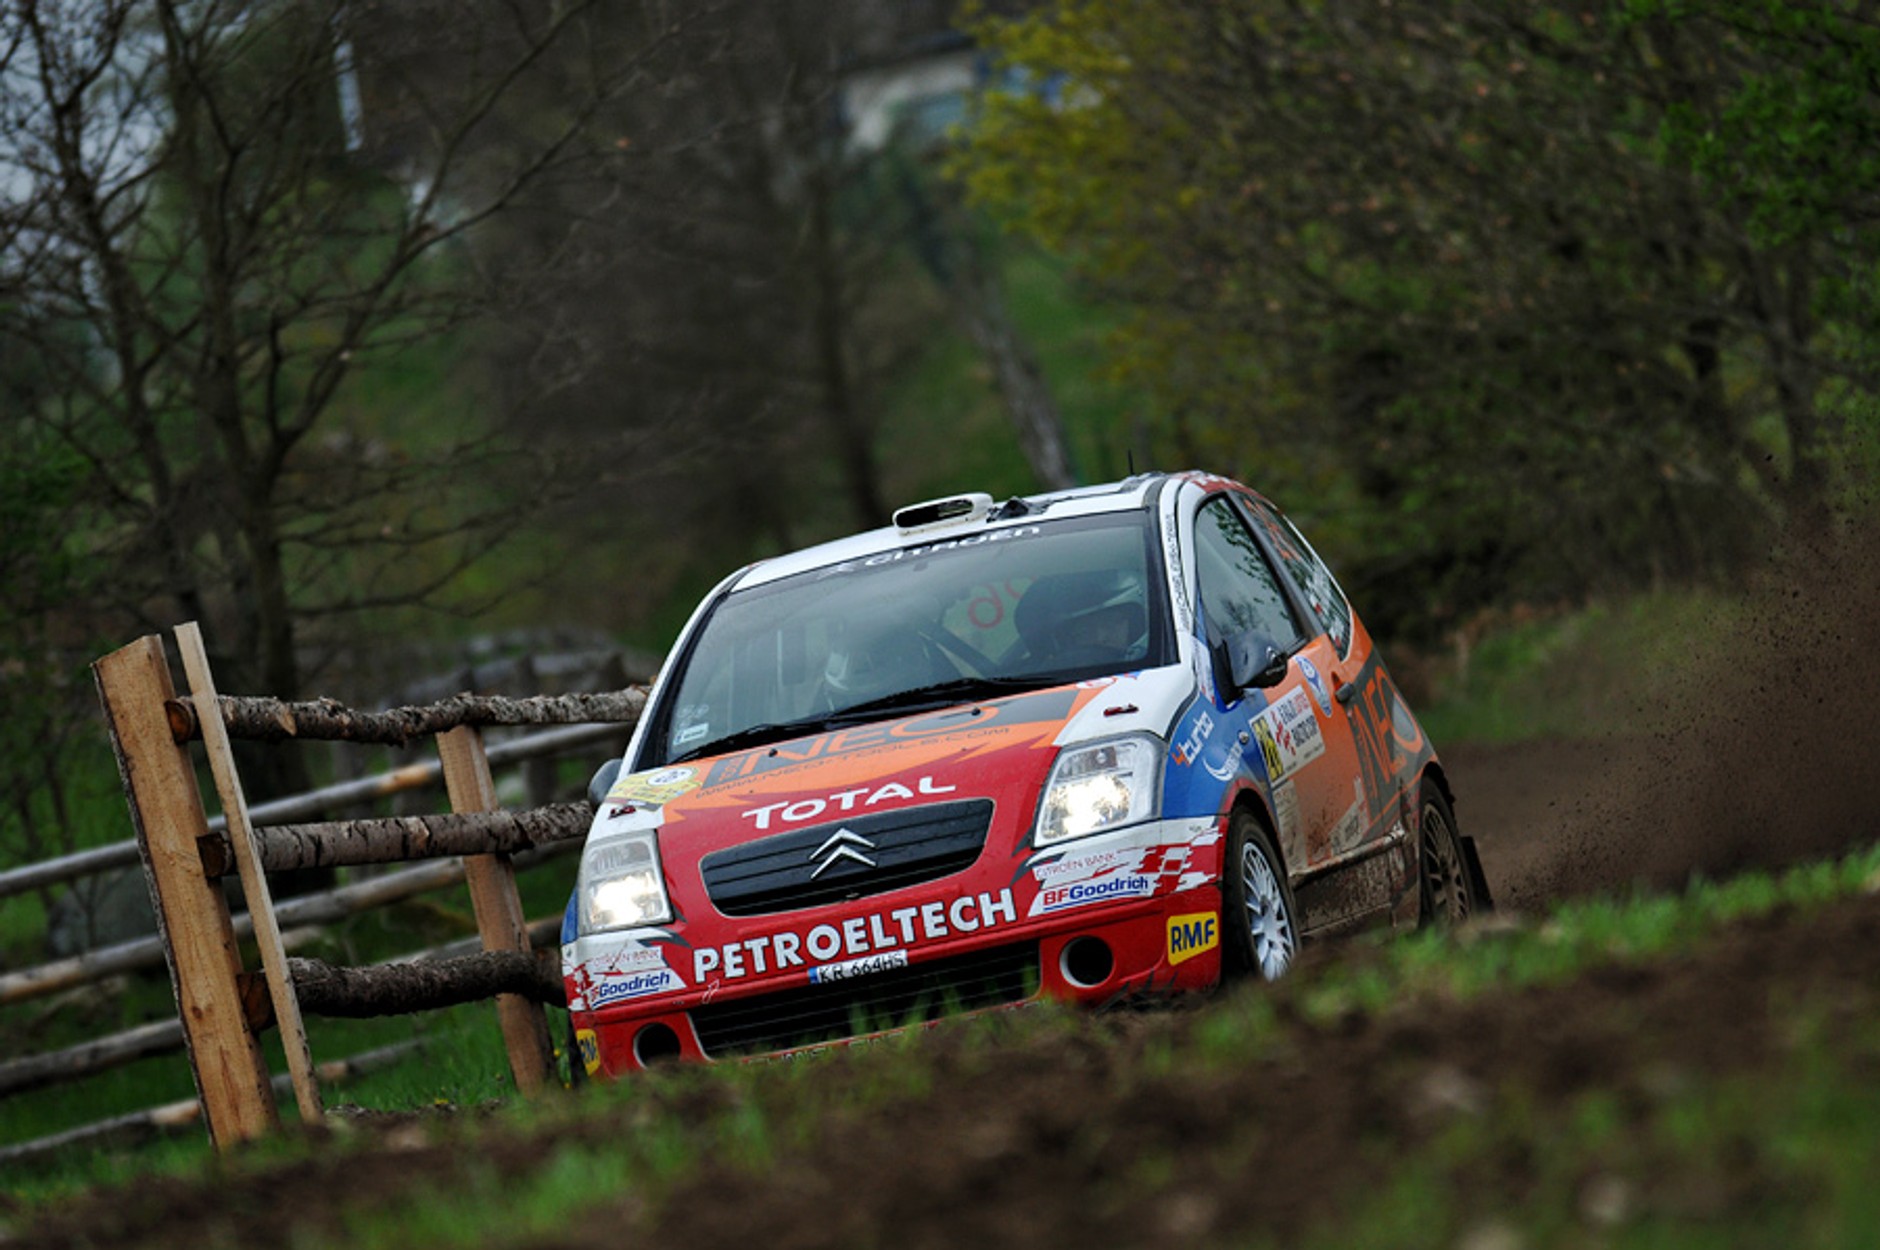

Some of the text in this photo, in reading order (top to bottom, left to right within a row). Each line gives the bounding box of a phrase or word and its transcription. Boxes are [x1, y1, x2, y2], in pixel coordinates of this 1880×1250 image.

[741, 776, 956, 829] TOTAL
[1043, 876, 1148, 906] BFGoodrich
[692, 887, 1018, 984] PETROELTECH
[1170, 918, 1215, 954] RMF
